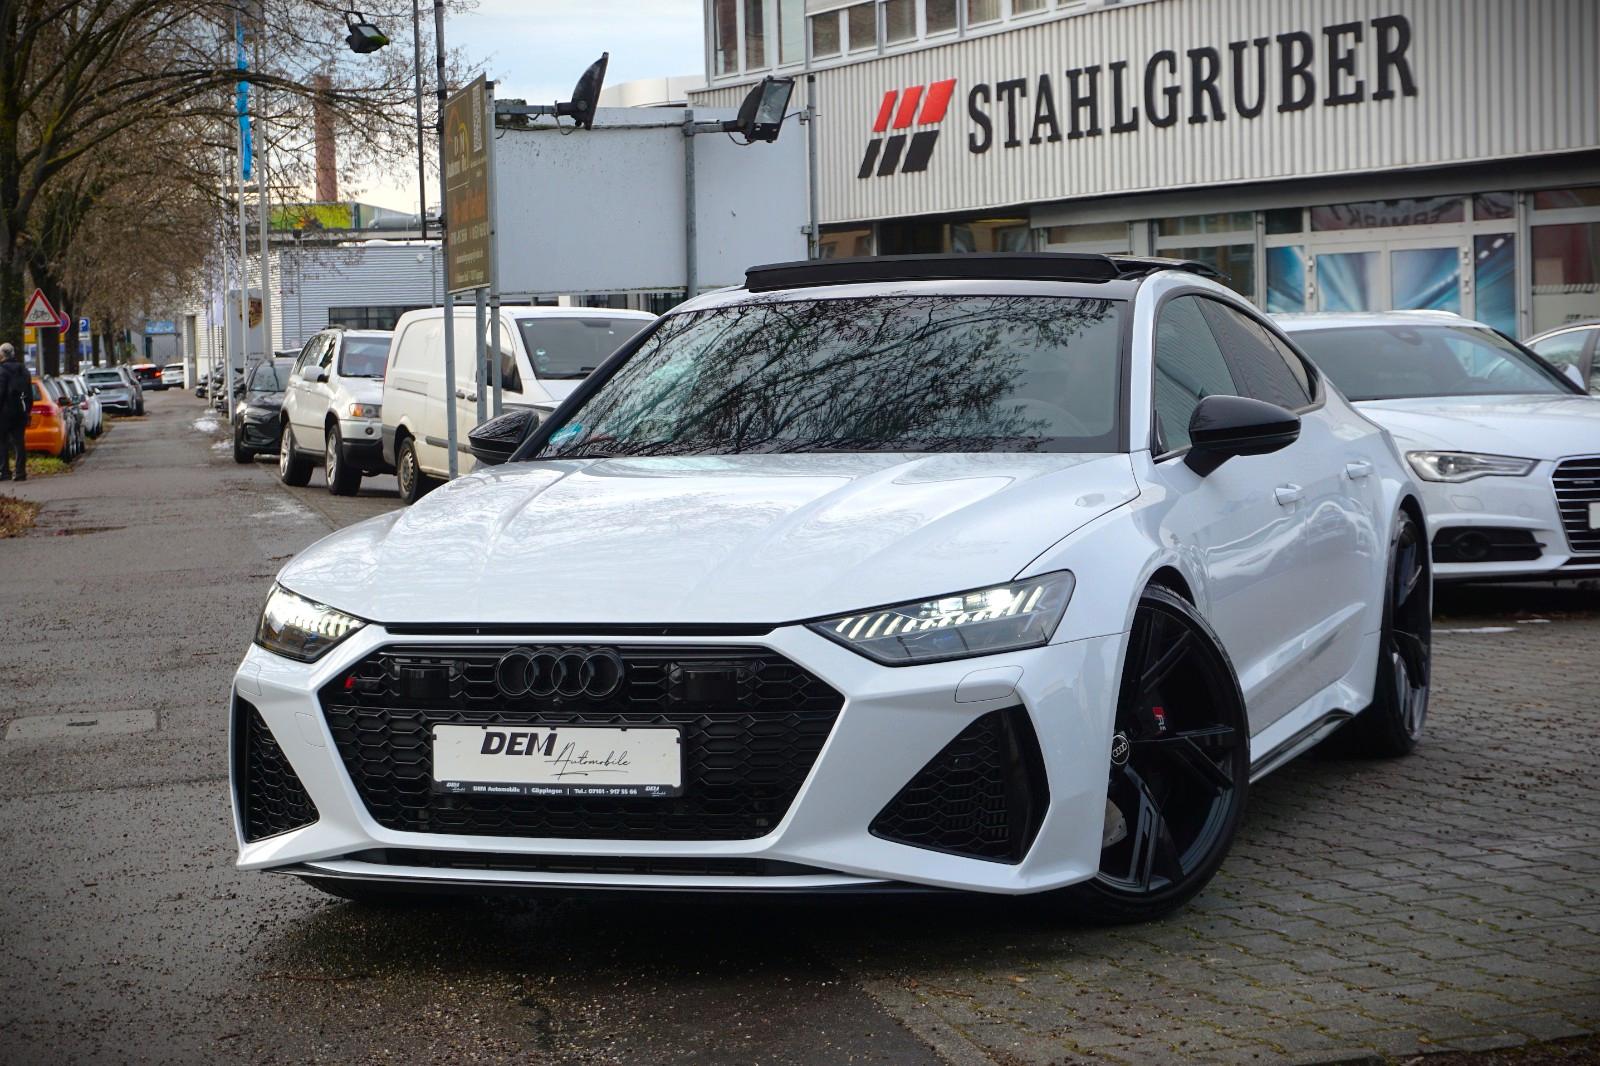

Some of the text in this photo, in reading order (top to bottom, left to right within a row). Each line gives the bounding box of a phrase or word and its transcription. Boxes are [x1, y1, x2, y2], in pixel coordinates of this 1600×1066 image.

[967, 14, 1418, 154] STAHLGRUBER
[480, 731, 558, 756] DEM
[544, 741, 631, 780] Automobile
